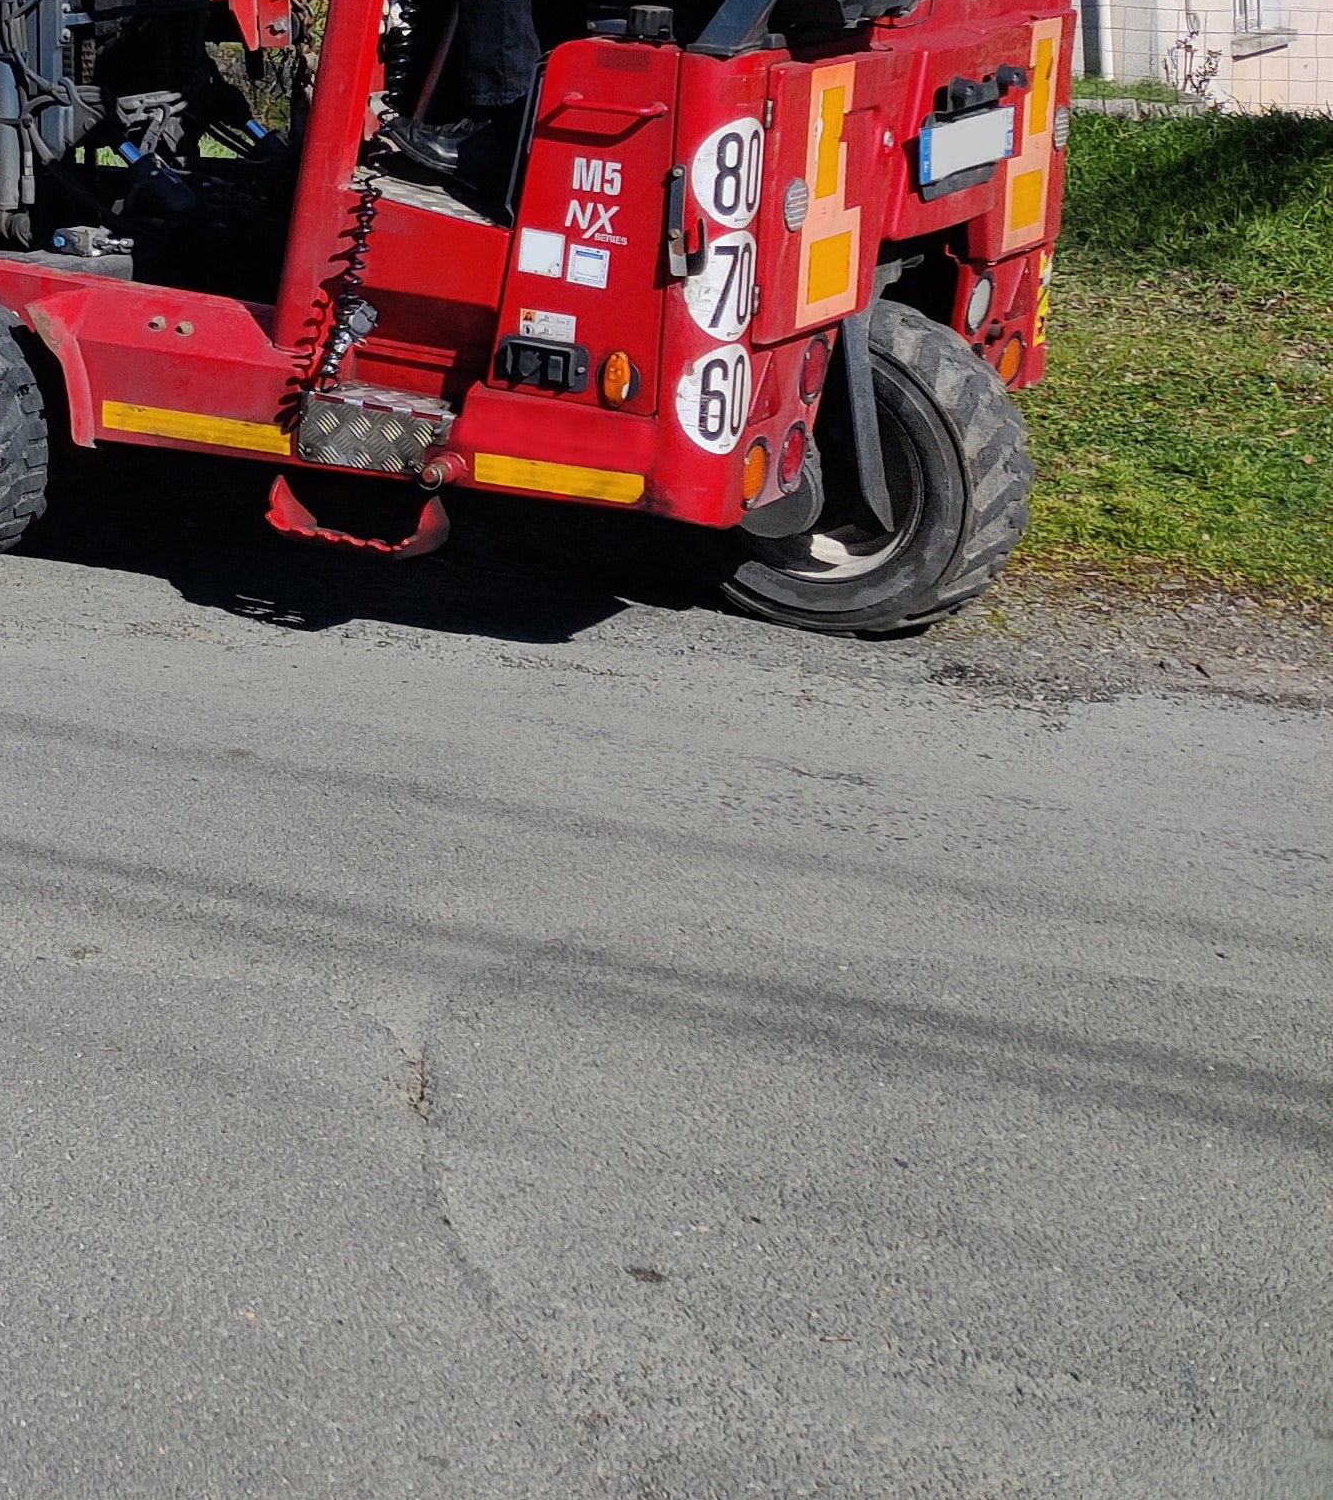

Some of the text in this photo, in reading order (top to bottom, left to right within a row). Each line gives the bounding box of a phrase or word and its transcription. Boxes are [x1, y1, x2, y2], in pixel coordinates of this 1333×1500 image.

[572, 156, 622, 196] M5
[714, 129, 760, 217] 80
[564, 199, 620, 239] NX
[708, 241, 753, 328] 70
[698, 353, 745, 442] 60
